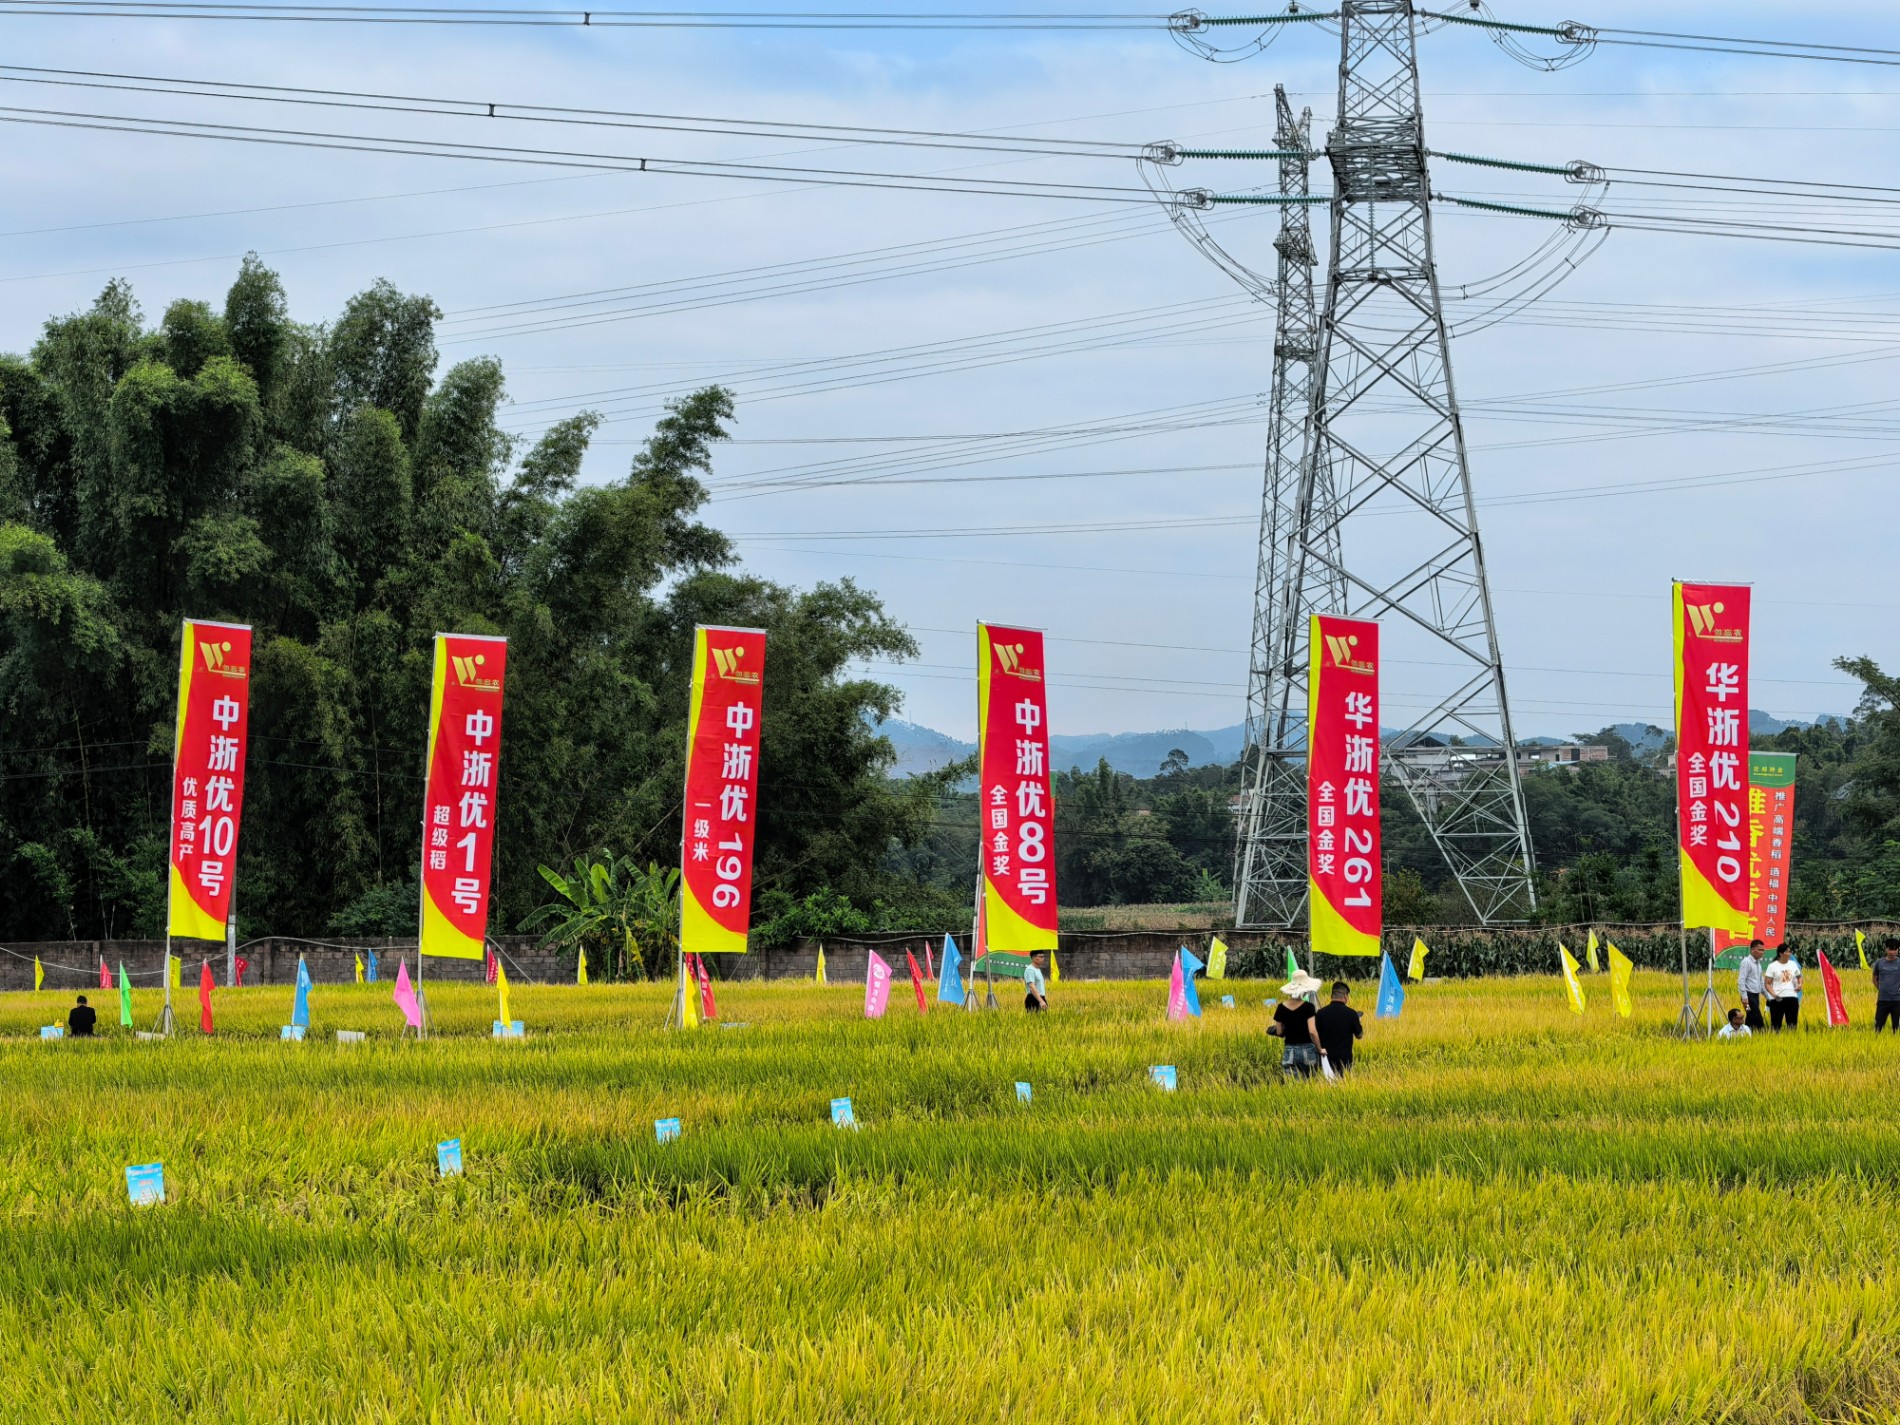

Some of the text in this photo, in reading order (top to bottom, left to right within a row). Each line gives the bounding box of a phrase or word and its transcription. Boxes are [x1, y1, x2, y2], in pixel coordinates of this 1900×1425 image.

[179, 776, 198, 862] 优质高产
[198, 695, 241, 898] 中浙优10号
[451, 709, 493, 914] 中浙优1号
[711, 701, 753, 908] 中浙优196
[1015, 697, 1050, 904] 中浙优8号
[1343, 691, 1374, 907] 华浙优261
[1688, 752, 1707, 847] 全国金奖
[1705, 662, 1741, 883] 华浙优210
[429, 805, 450, 871] 超级稻
[692, 802, 711, 862] 一级米
[989, 784, 1010, 876] 全国金奖
[1317, 781, 1336, 876] 全国金奖
[1770, 791, 1787, 860] 推广高端香稻
[1764, 866, 1781, 938] 造福中国人民
